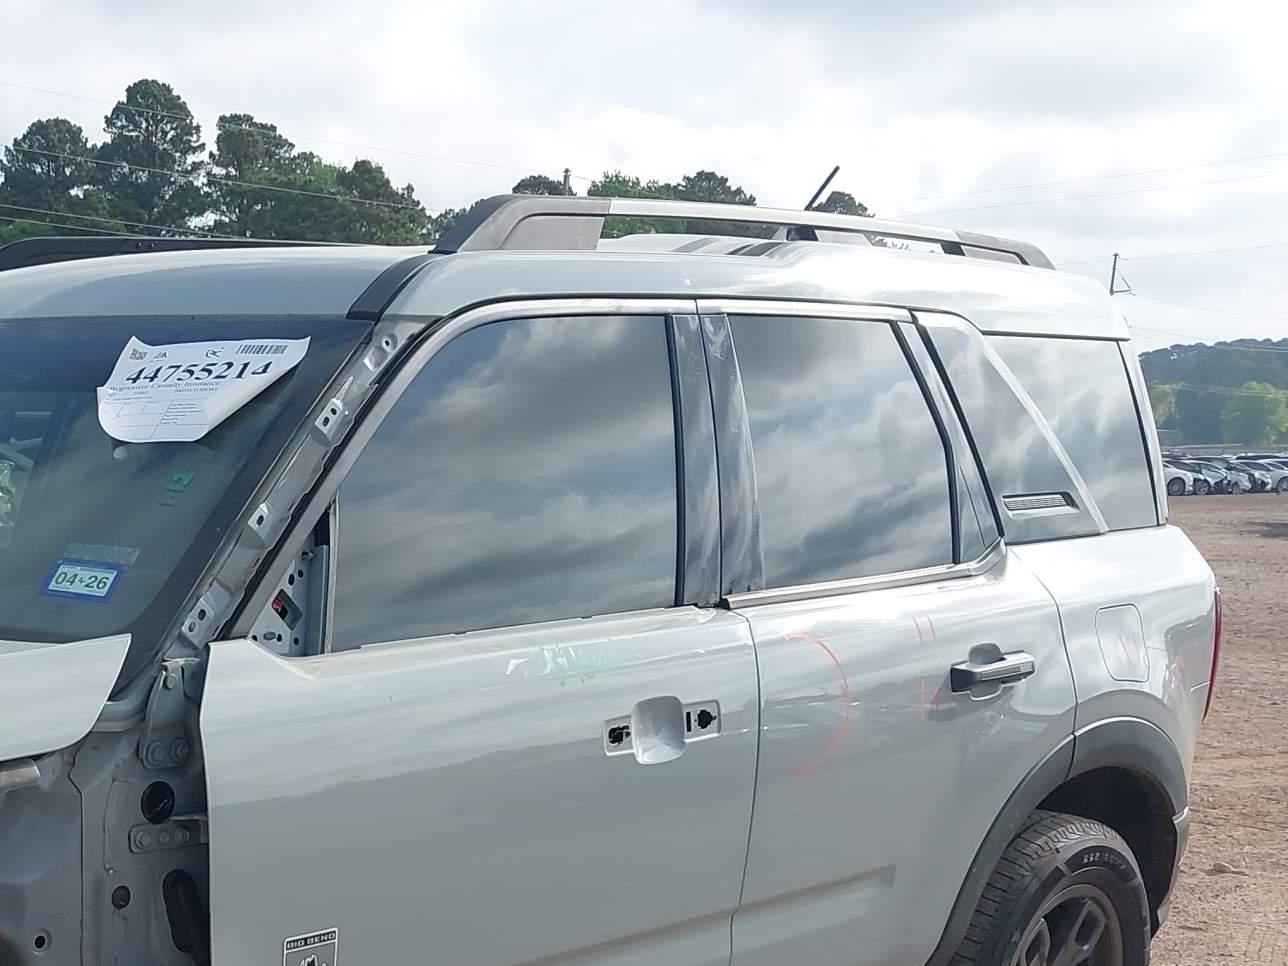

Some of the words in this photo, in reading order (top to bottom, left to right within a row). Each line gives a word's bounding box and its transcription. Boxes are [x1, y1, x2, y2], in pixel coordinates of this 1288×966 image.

[125, 361, 273, 384] 44755214
[287, 940, 305, 949] BIG
[306, 933, 336, 945] BEND
